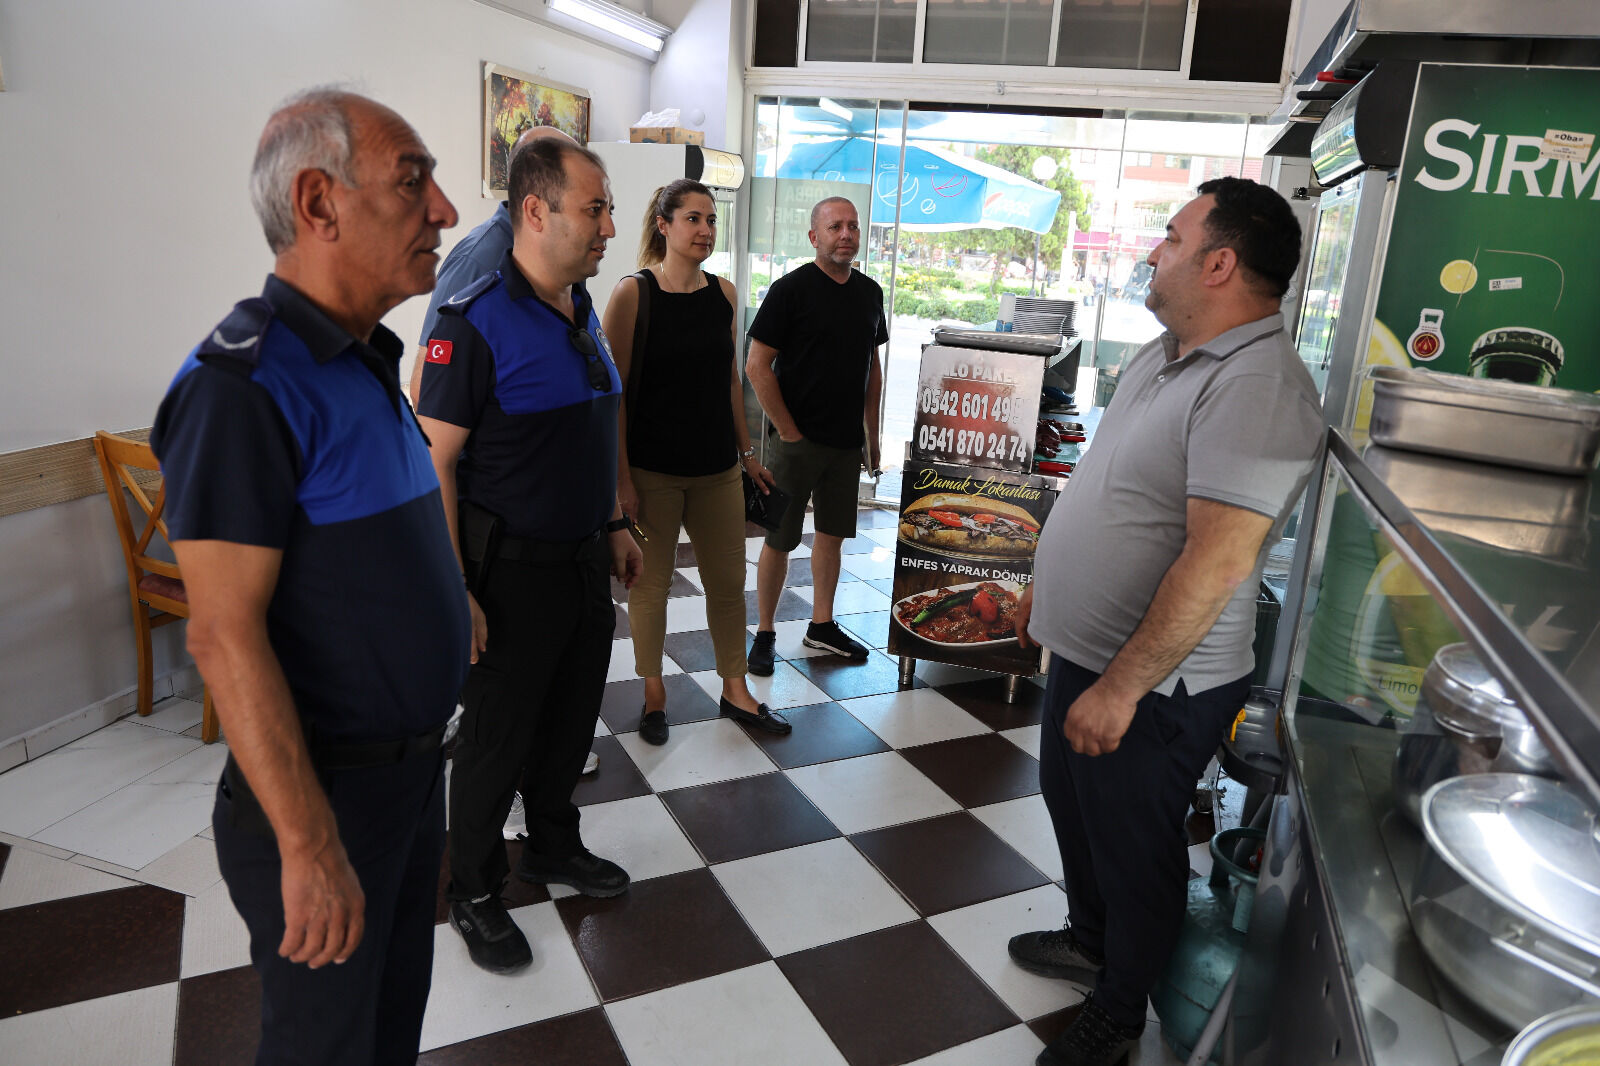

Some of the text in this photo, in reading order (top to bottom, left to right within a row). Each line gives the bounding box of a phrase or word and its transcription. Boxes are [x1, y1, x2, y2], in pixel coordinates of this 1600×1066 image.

[922, 388, 959, 417] 0542
[961, 393, 989, 420] 601
[919, 425, 1027, 463] 0541 870 24 74
[913, 468, 1041, 501] Damak Lokantası
[901, 557, 938, 571] ENFES
[941, 562, 990, 578] YAPRAK
